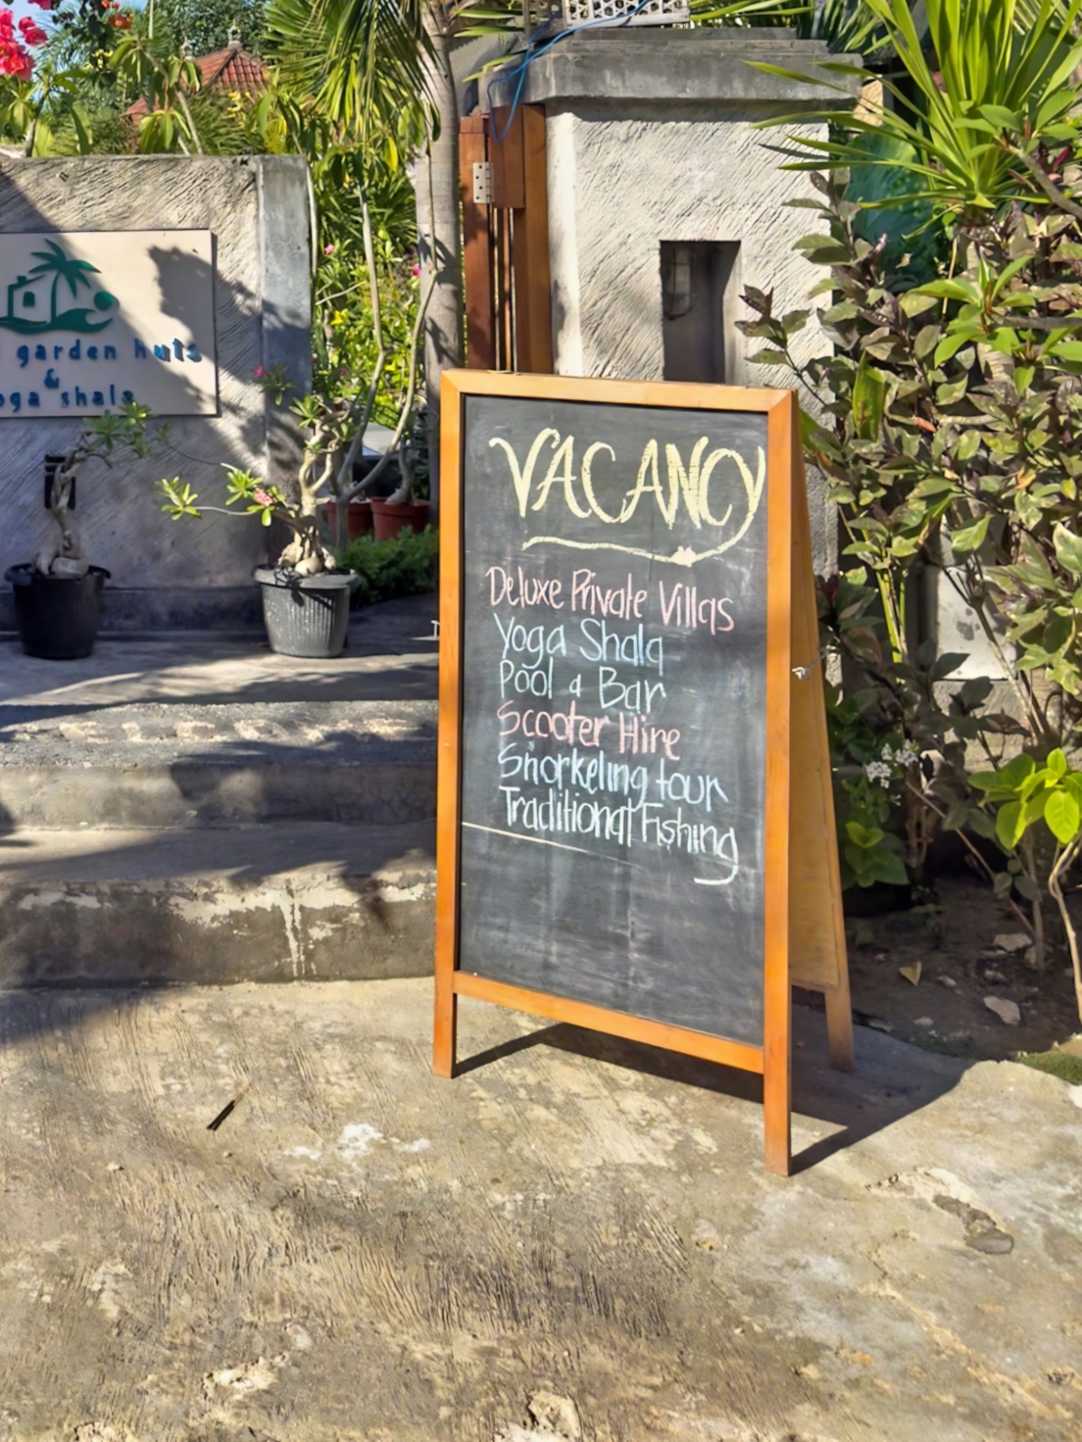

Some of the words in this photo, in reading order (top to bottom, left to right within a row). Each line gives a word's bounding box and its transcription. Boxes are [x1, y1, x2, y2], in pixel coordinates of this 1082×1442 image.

[17, 339, 117, 368] garden
[134, 338, 202, 363] huts
[44, 368, 60, 389] &
[61, 385, 135, 408] shala
[489, 427, 766, 544] VACANCY
[485, 566, 564, 609] Deluxe
[572, 569, 647, 620] Private
[659, 580, 735, 635] Villas
[494, 613, 567, 670] Yoga
[580, 618, 664, 676] Shala
[499, 657, 553, 699] Pool
[599, 666, 666, 713] Bar
[497, 700, 610, 747] Scooter
[619, 711, 681, 760] Hire
[498, 742, 647, 812] Snorkeling
[656, 758, 729, 811] tour
[498, 786, 632, 847] Traditional
[642, 803, 739, 885] Fishing
